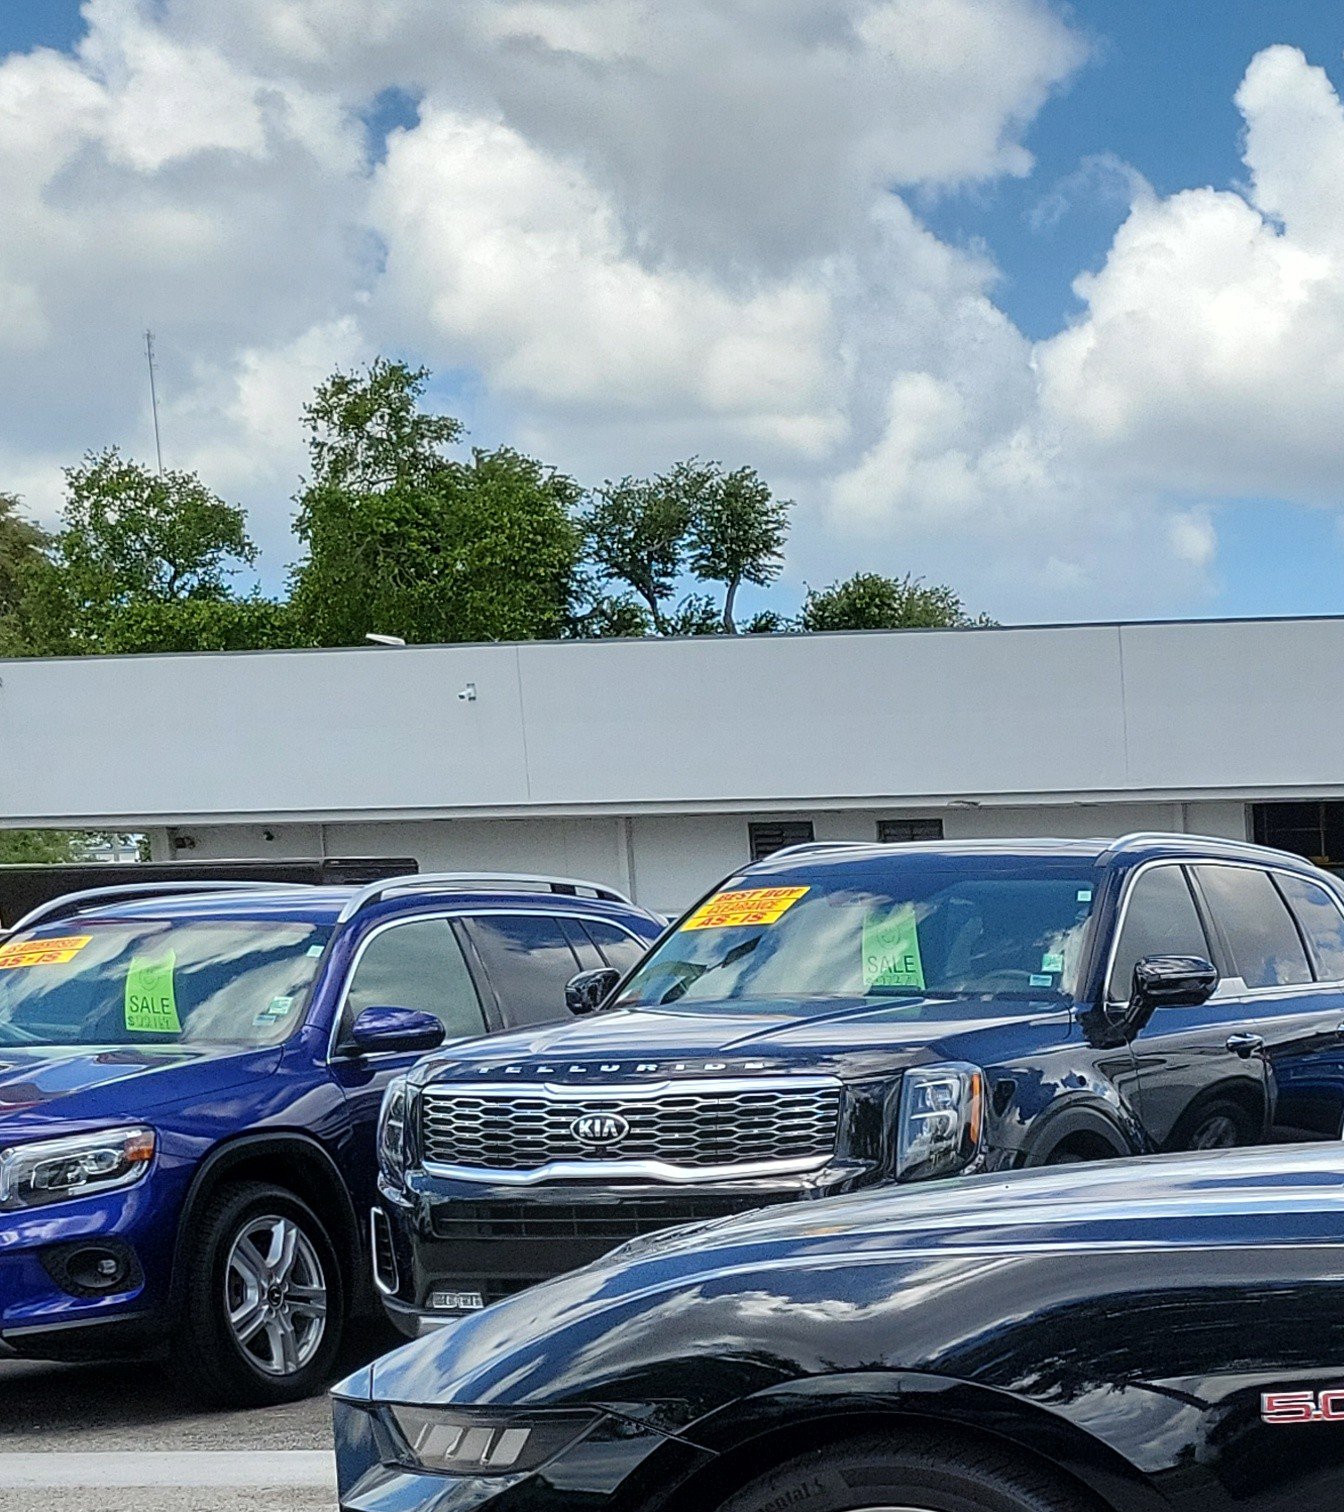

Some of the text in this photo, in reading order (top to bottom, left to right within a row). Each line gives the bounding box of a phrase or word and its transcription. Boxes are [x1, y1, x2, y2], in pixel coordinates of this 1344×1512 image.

[714, 888, 804, 902] BEST BUY
[697, 912, 767, 927] AS-IS
[868, 955, 917, 974] SALE
[130, 995, 171, 1014] SALE
[478, 1062, 767, 1074] TELLURIDE
[579, 1119, 618, 1138] KIA
